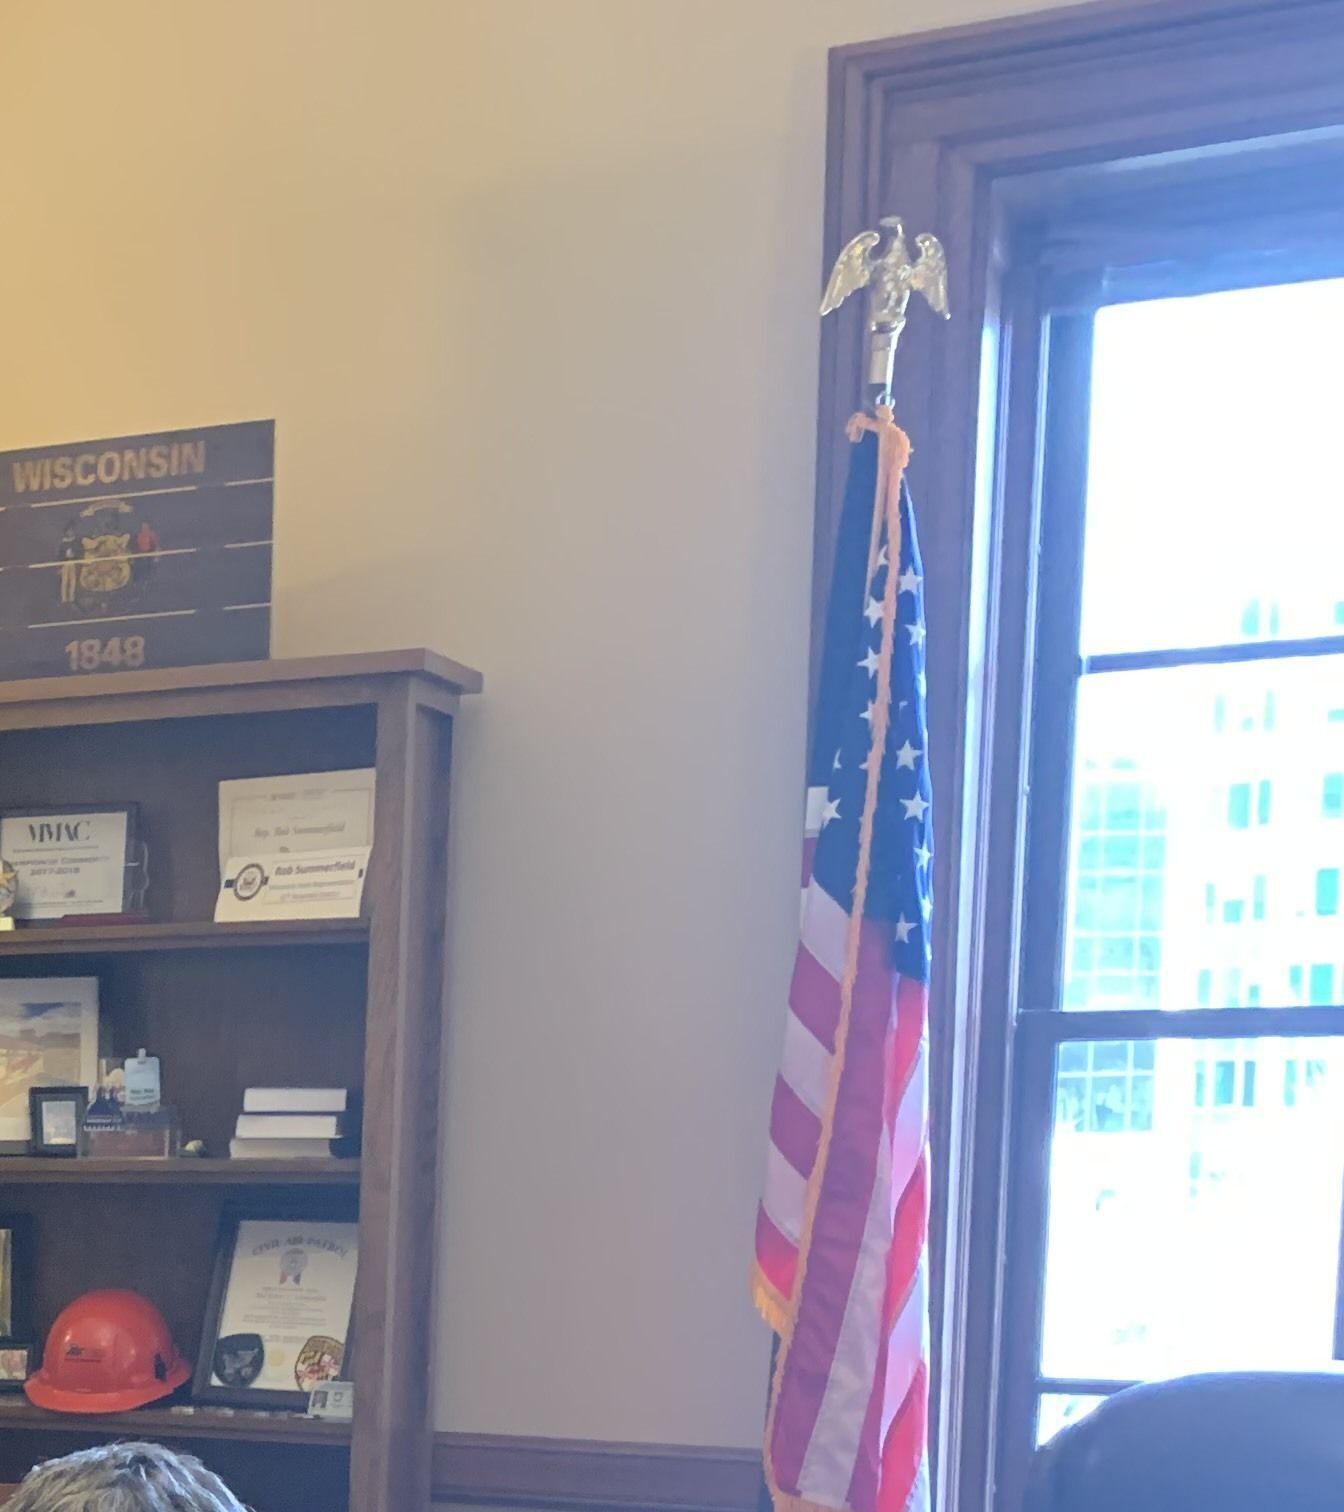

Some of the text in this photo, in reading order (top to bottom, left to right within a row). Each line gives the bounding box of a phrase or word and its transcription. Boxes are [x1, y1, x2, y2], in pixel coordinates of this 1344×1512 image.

[13, 441, 205, 492] WISCONSIN
[65, 635, 144, 671] 1848
[296, 860, 356, 875] Summerfield
